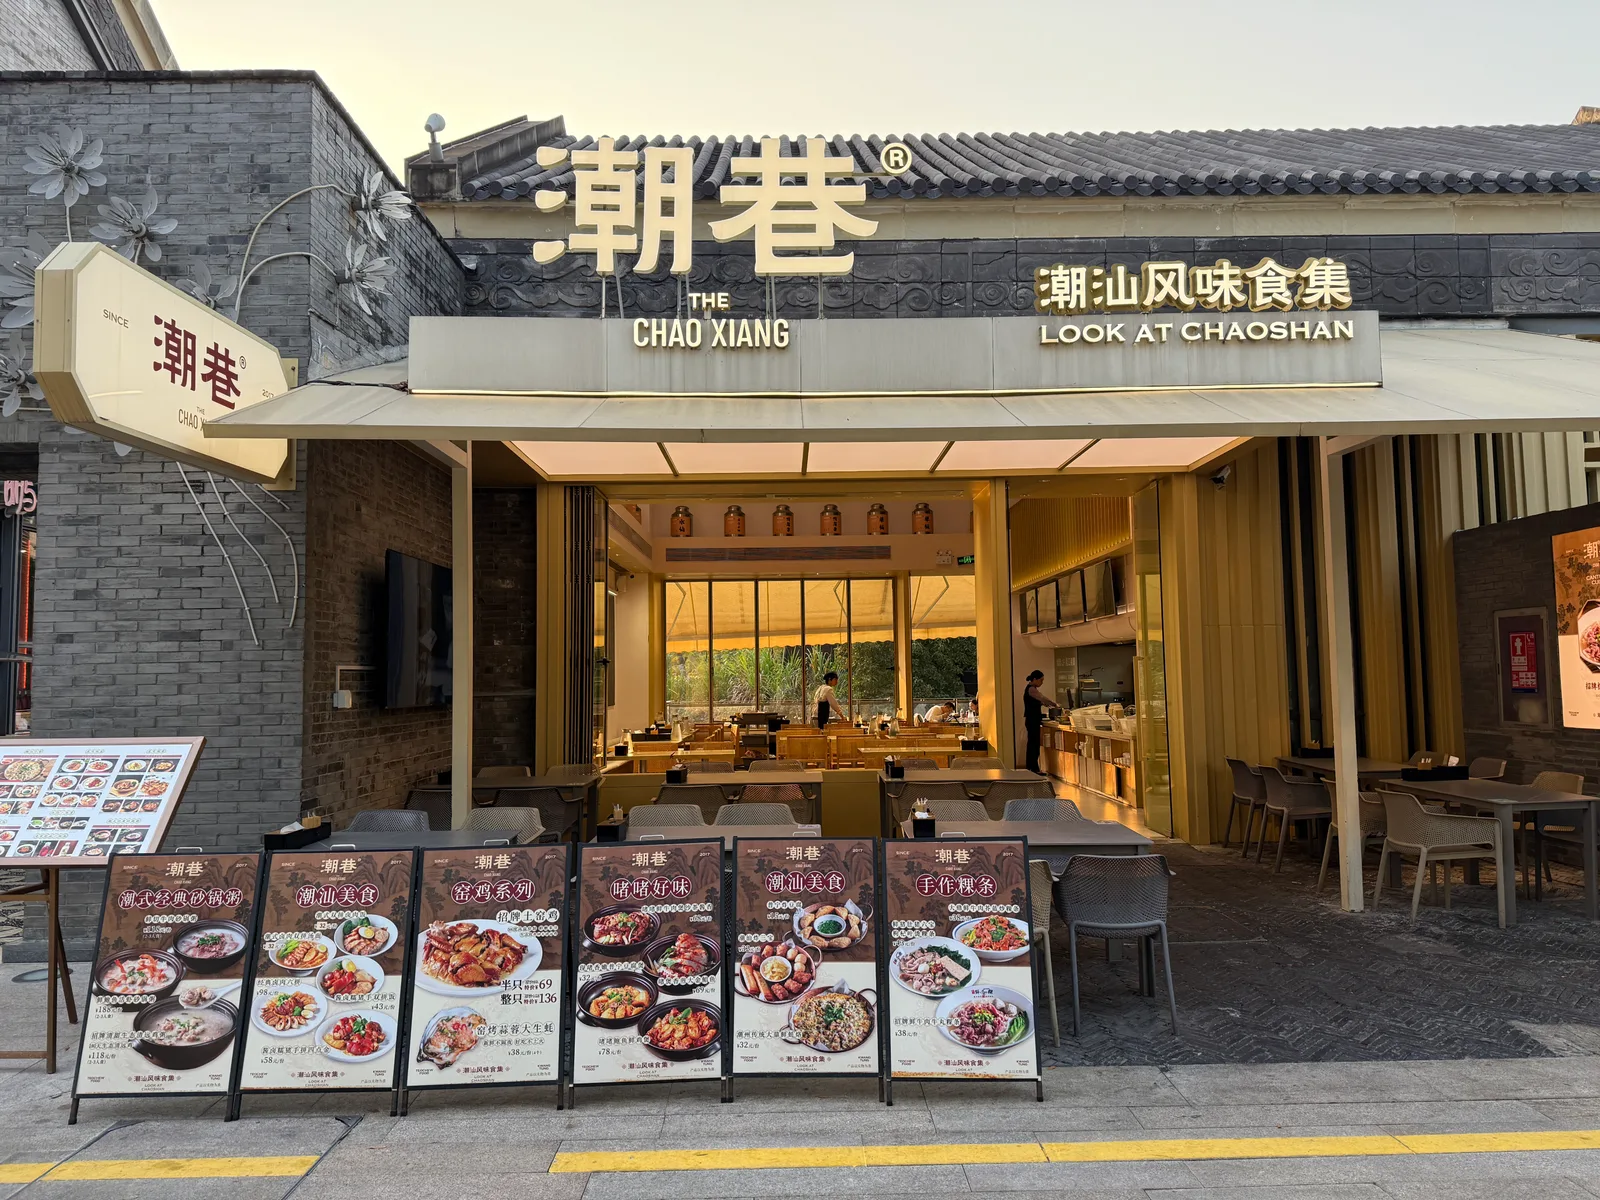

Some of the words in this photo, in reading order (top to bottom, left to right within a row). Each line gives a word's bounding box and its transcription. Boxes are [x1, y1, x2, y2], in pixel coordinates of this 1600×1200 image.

[533, 138, 879, 277] 潮巷
[1039, 258, 1352, 308] 潮汕风味食集
[689, 292, 729, 311] THE
[103, 309, 129, 328] SINCE
[633, 318, 702, 349] CHAO
[711, 318, 790, 349] XIANG
[1041, 323, 1126, 344] LOOK
[1134, 322, 1173, 343] AT
[1181, 320, 1354, 342] CHAOSHAN
[153, 314, 241, 410] 潮巷
[178, 408, 198, 430] CHAO
[196, 406, 205, 415] THE
[1583, 542, 1600, 559] 潮
[475, 854, 511, 869] 潮巷
[632, 852, 667, 867] 潮巷
[786, 846, 821, 861] 潮巷
[936, 849, 971, 863] 潮巷
[165, 861, 204, 877] 潮巷
[320, 858, 357, 873] 潮巷
[451, 879, 535, 904] 窑鸡系列
[610, 876, 691, 901] 啫啫好味
[765, 871, 845, 893] 潮汕美食
[916, 874, 997, 897] 手作粿条
[119, 888, 243, 909] 潮式经典砂锅粥
[296, 884, 379, 907] 潮汕美食
[496, 908, 560, 923] 招牌土窑鸡
[501, 980, 522, 990] 半只
[501, 994, 522, 1005] 整只
